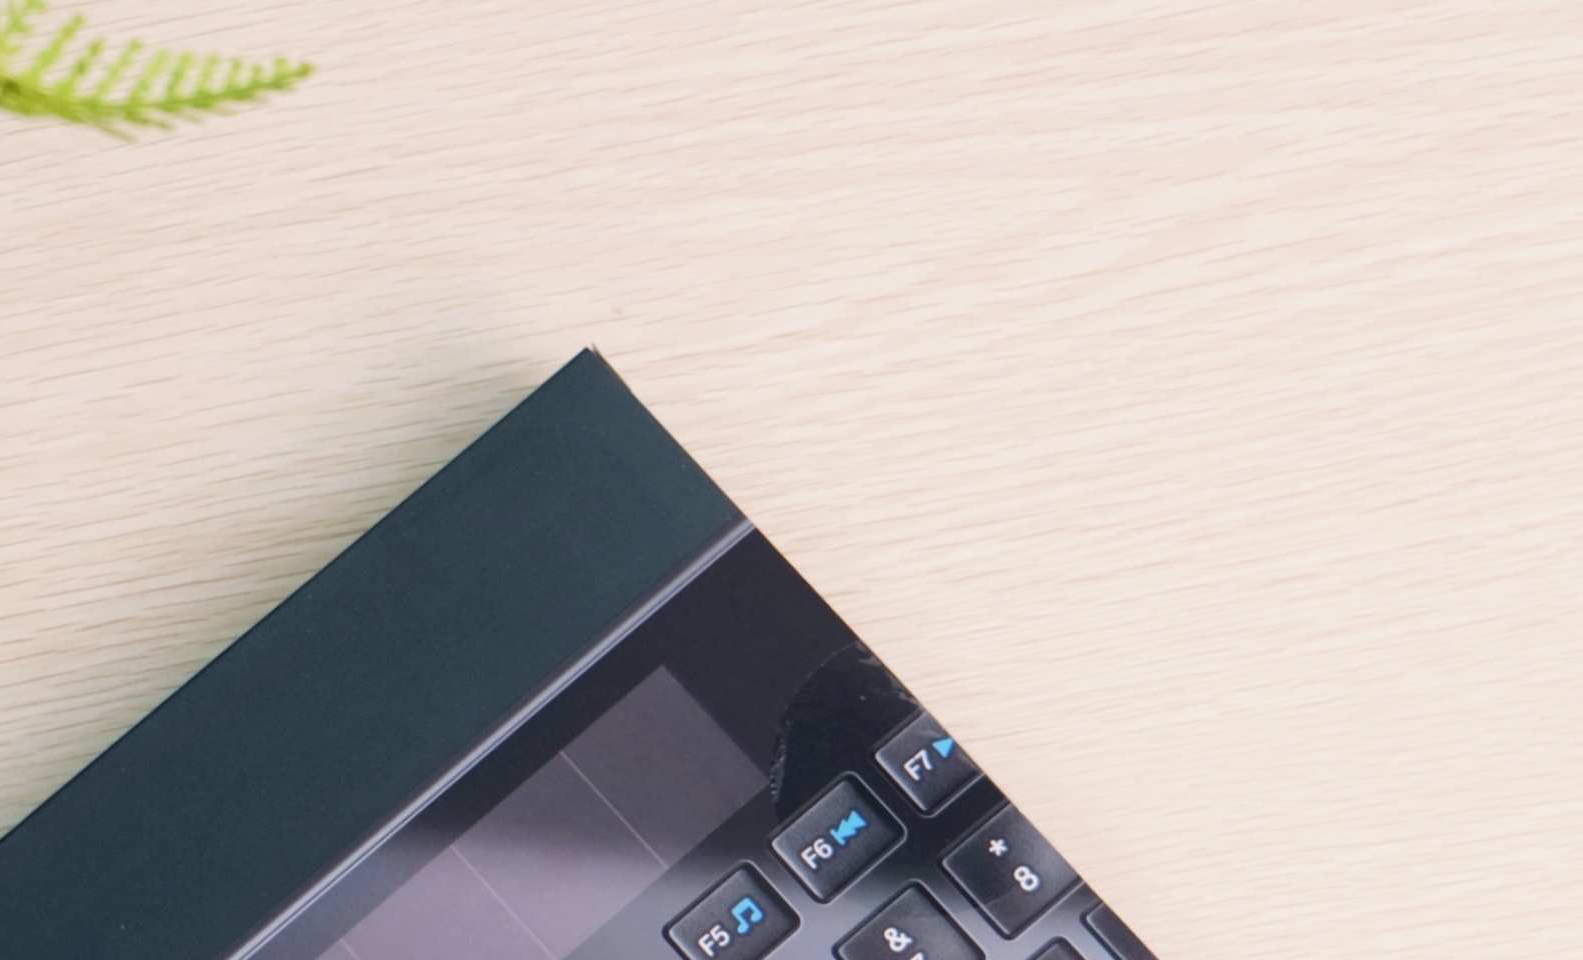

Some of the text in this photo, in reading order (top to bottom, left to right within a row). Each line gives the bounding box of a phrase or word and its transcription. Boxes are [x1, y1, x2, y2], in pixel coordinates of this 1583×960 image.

[903, 749, 932, 781] F7
[800, 838, 833, 869] F6
[1013, 865, 1039, 892] 8
[698, 924, 730, 957] F5
[883, 927, 912, 952] &
